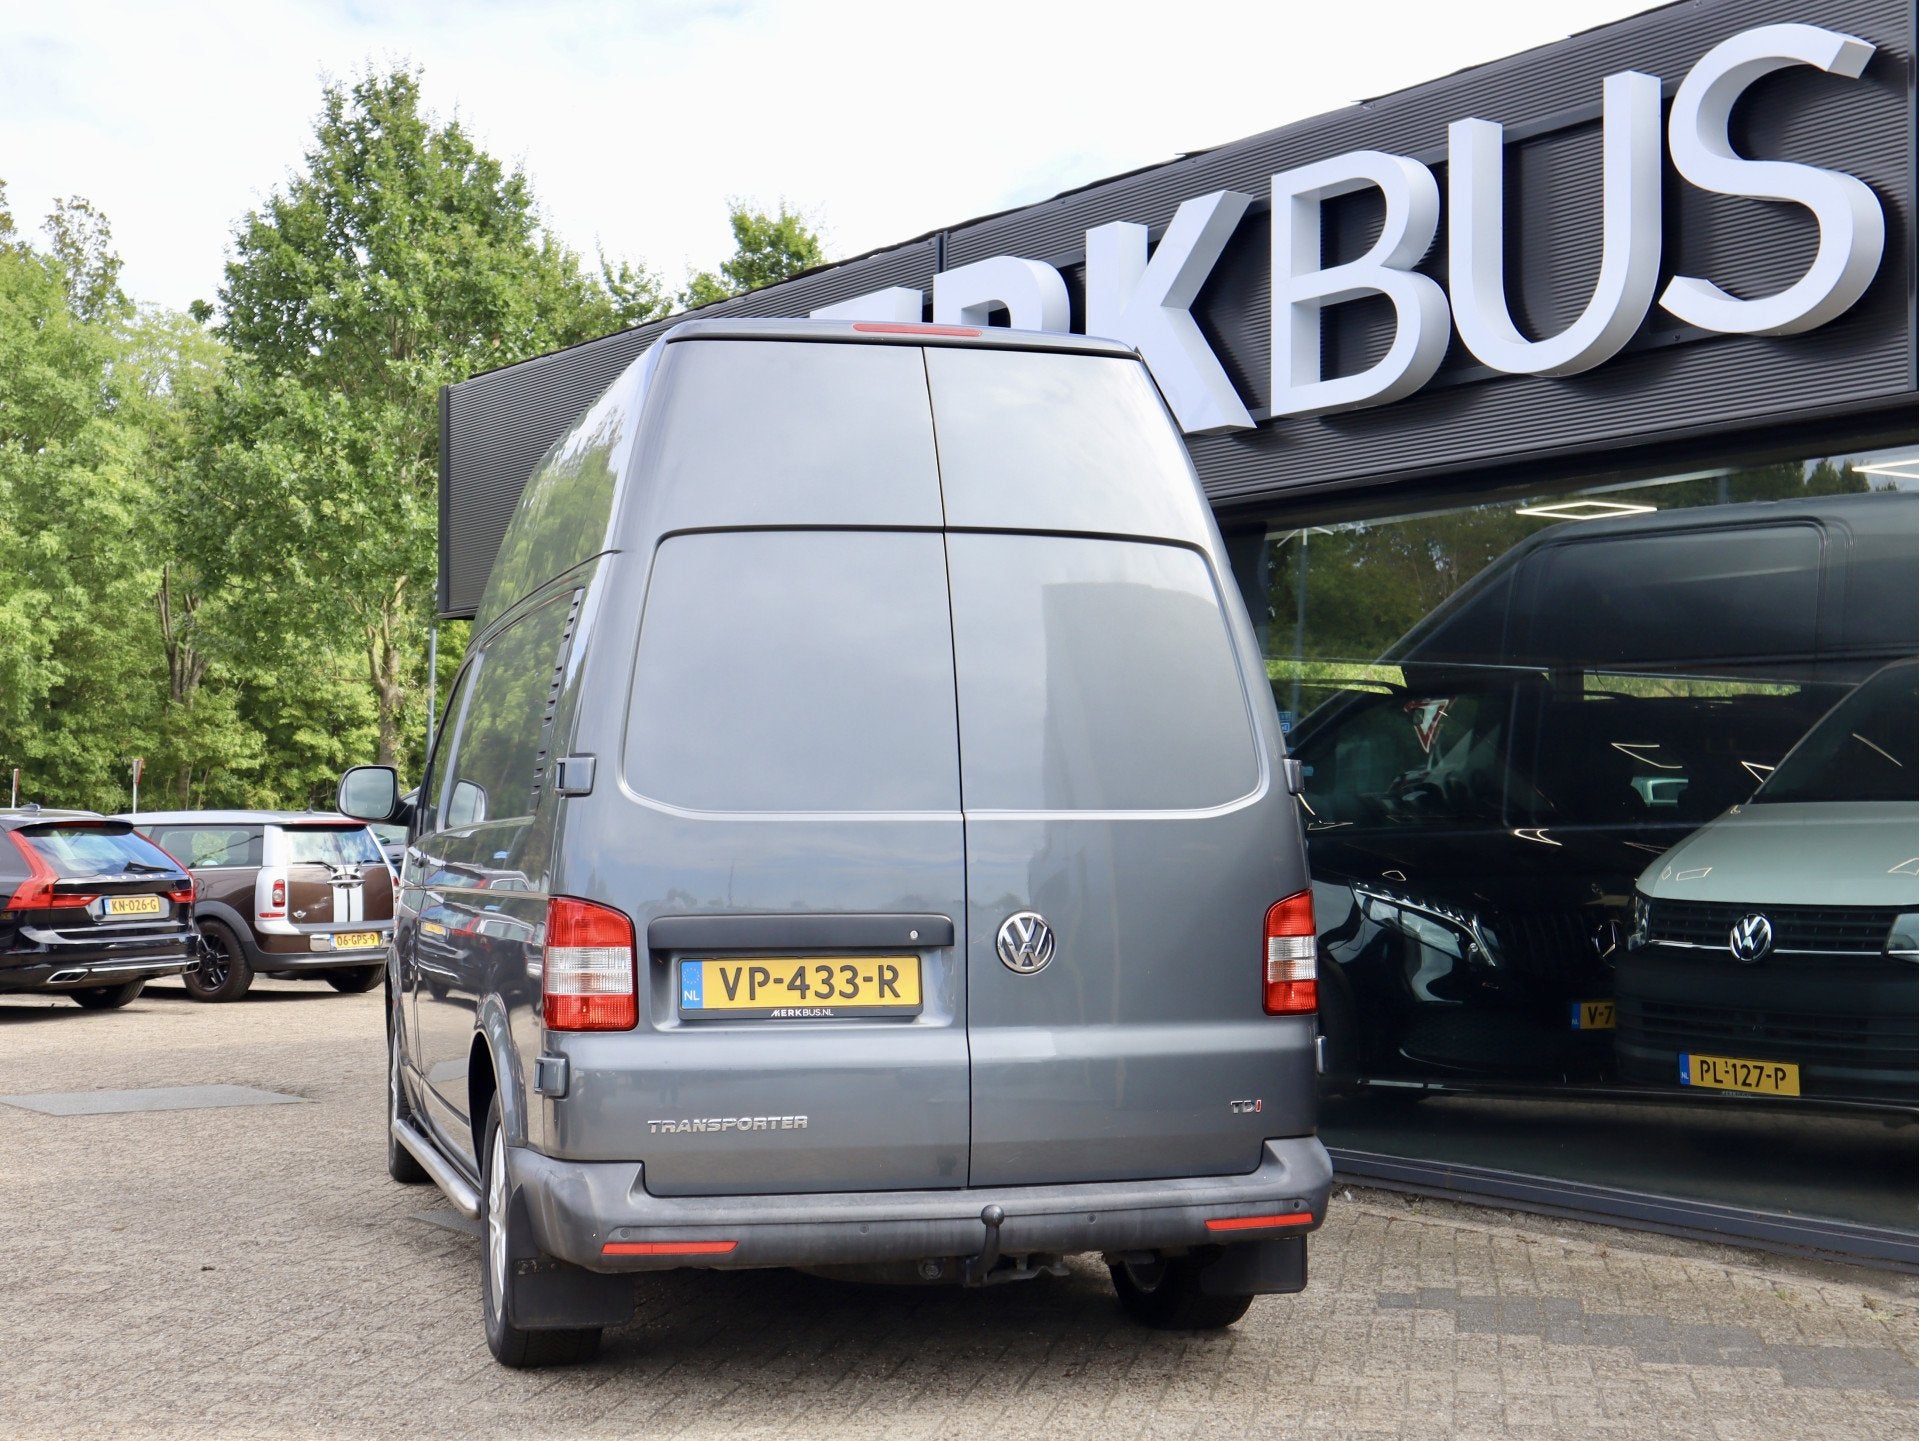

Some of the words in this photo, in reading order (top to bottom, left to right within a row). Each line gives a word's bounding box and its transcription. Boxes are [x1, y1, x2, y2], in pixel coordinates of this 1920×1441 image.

[111, 899, 157, 912] KN-026-G
[336, 934, 376, 946] 06-GPS-9
[684, 990, 700, 1001] NL
[719, 964, 901, 1001] VP-433-R
[770, 1008, 834, 1017] MERKBUS.NL
[1681, 1072, 1689, 1080] NL
[1700, 1060, 1787, 1090] PL-127-P
[1230, 1099, 1262, 1114] TDI
[647, 1115, 808, 1134] TRANSPORTER
